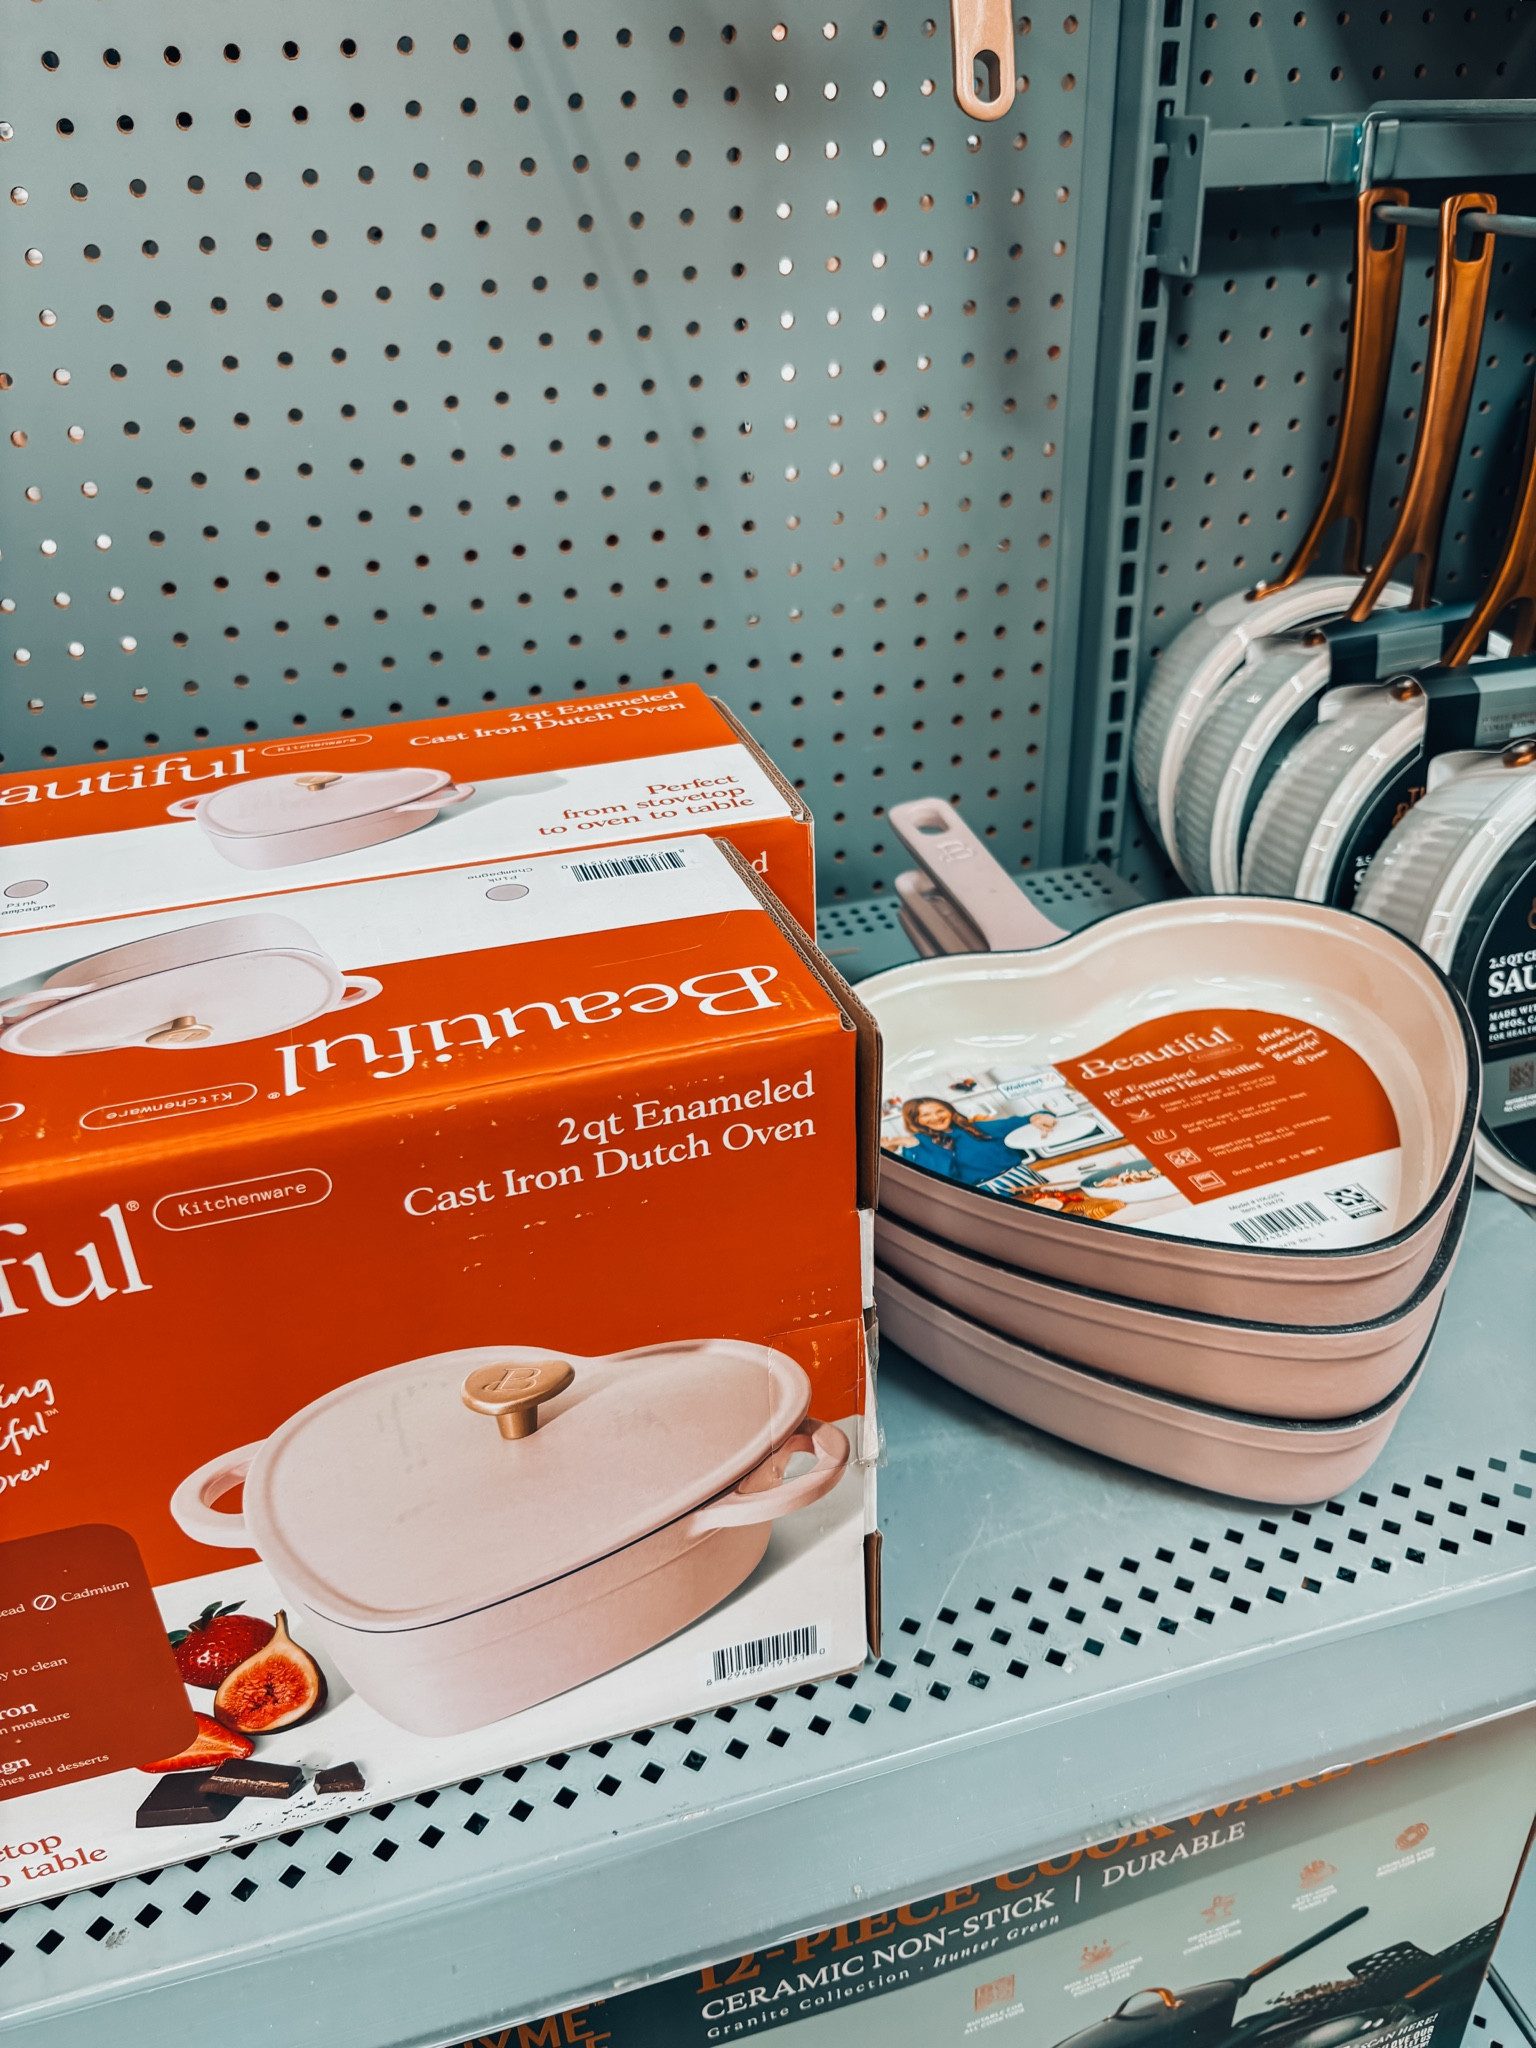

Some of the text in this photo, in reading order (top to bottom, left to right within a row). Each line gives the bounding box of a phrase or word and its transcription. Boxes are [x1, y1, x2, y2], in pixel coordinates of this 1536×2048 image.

[509, 690, 679, 723] 2qt Enameled
[409, 702, 686, 747] Cast Iron Dutch Oven
[646, 774, 739, 795] Perfect
[538, 798, 755, 836] to oven to table
[562, 786, 746, 820] from stovetop
[467, 868, 534, 881] Champagne
[488, 875, 518, 884] Pink
[6, 900, 37, 909] Pink
[1506, 951, 1524, 967] QT
[1488, 1007, 1518, 1022] MADE
[1256, 1028, 1319, 1056] Something
[1258, 1026, 1291, 1044] Make
[1077, 1026, 1235, 1080] Beautiful
[1110, 1061, 1265, 1108] Cast Iron Heart Skillet
[1125, 1068, 1197, 1094] Enameled
[106, 1090, 234, 1119] Kitchenware
[558, 1069, 815, 1147] 2qt Enameled
[403, 1115, 817, 1217] Cast Iron Dutch Oven
[178, 1182, 308, 1218] Kitchenware
[481, 1367, 542, 1393] B
[61, 1580, 130, 1602] Cadmium
[12, 1666, 28, 1677] to
[31, 1656, 69, 1673] clean
[727, 1665, 764, 1681] 29486
[771, 1651, 807, 1669] 19151
[11, 1711, 72, 1732] moisture
[29, 1766, 53, 1781] and
[57, 1753, 110, 1774] desserts
[21, 1847, 109, 1882] table
[701, 1821, 1246, 2020] CERAMIC NON-STICK DURABLE
[706, 1913, 1061, 2040] Granite Collection Hunter Green
[1398, 2012, 1439, 2036] HERE!
